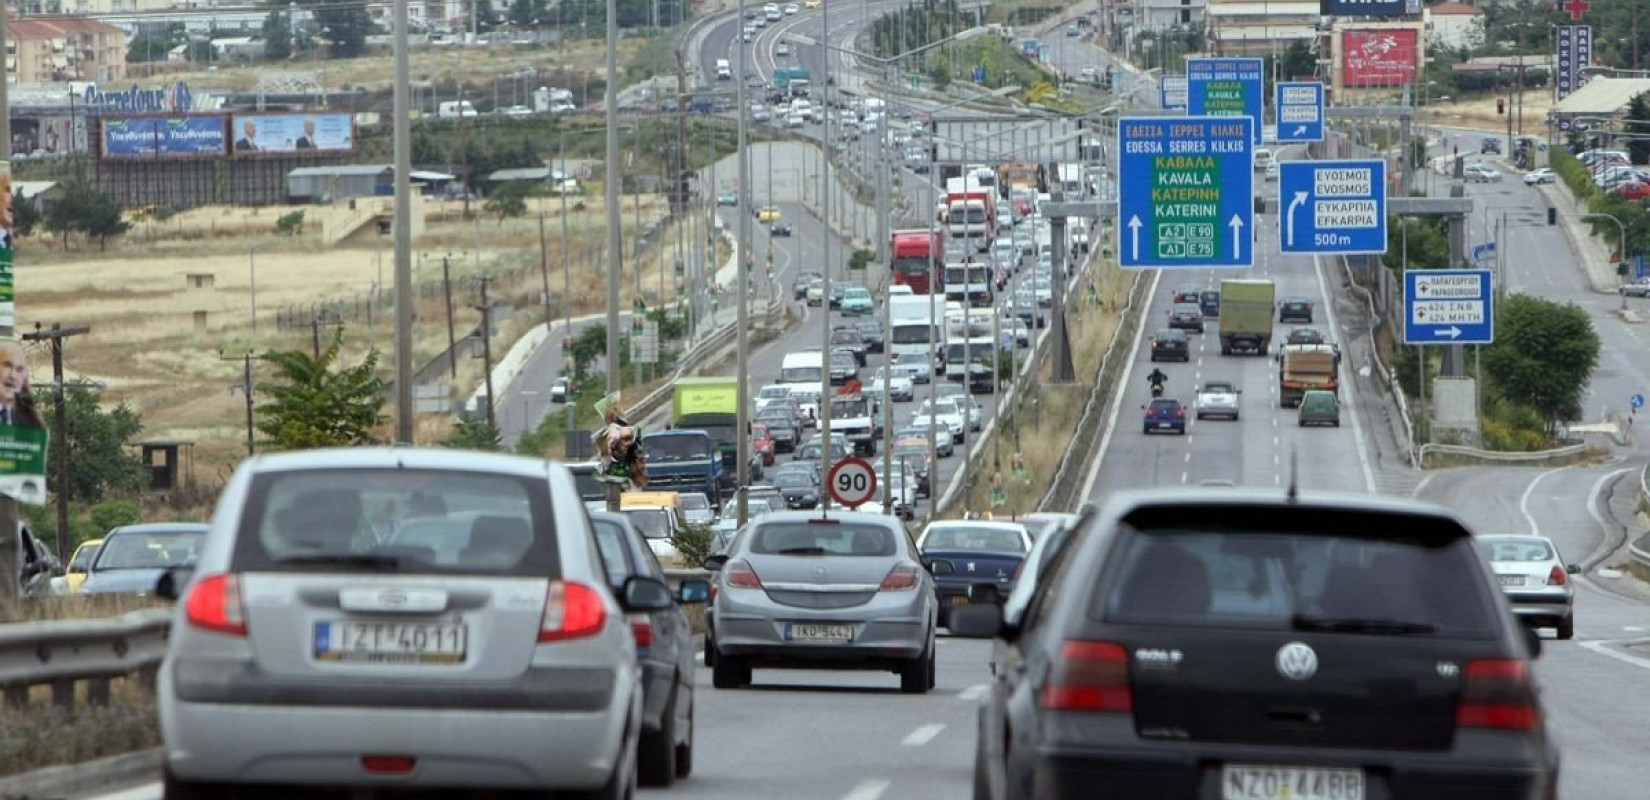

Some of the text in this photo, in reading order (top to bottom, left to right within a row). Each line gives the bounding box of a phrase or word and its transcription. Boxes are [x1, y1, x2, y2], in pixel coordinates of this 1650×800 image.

[1126, 125, 1244, 137] ΕΔΕΣΣΑ ΣΕΡΡΕΣ ΚΙΛΚΙΣ
[1126, 140, 1244, 153] EDESSA SERRES KILKIS
[1155, 156, 1214, 169] ΚΑΒΑΛΑ
[1159, 172, 1211, 185] KAVALA
[1317, 170, 1369, 180] ΕΥΟΣΜΟΣ
[1152, 188, 1219, 200] ΚΑΤΕΡΙΝΗ
[1317, 184, 1369, 194] EVOSMOS
[1155, 204, 1216, 216] KATERINI
[1317, 202, 1375, 212] ΕΥΚΑΡΠΙΑ
[1317, 215, 1374, 225] EFKARPIA
[1165, 227, 1179, 237] A2
[1315, 233, 1337, 246] 500
[1166, 245, 1179, 255] A1
[838, 473, 867, 492] 90
